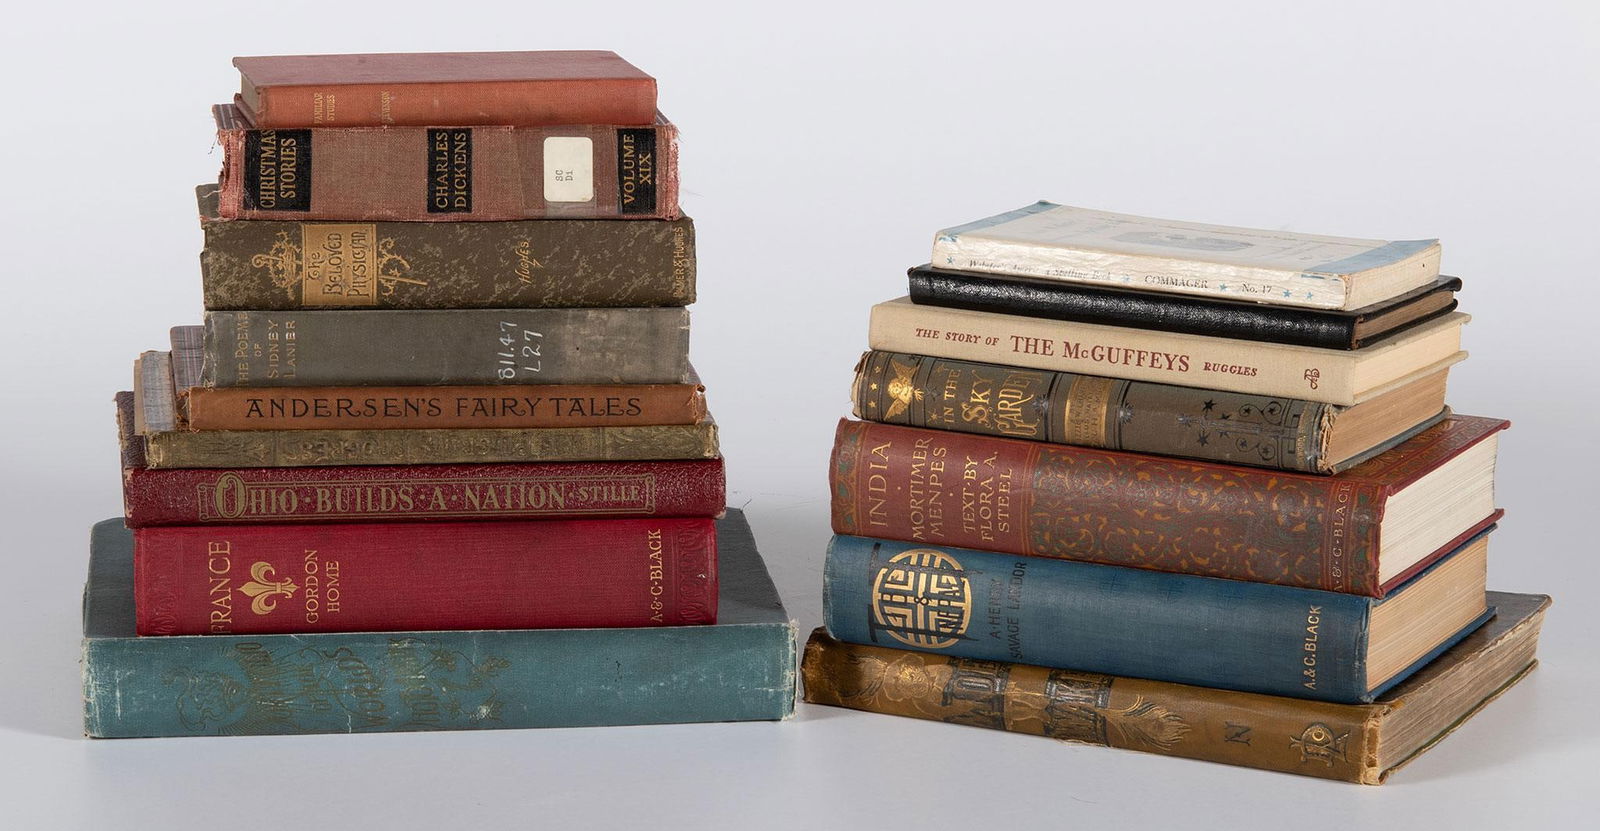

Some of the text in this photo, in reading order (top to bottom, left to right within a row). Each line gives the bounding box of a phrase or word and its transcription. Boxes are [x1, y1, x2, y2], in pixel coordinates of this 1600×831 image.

[260, 129, 277, 208] CHRISTMAS
[280, 138, 297, 198] STORIES
[435, 131, 449, 209] CHARLES
[454, 131, 467, 208] DICKENS
[555, 169, 564, 181] SC
[623, 133, 635, 205] VOLUME
[640, 152, 652, 185] XIX
[1144, 274, 1208, 290] COMMAGER
[1241, 283, 1273, 294] No. 17
[235, 311, 249, 387] THE POEMS
[253, 343, 262, 357] OF
[268, 319, 279, 378] SIDNEY
[283, 320, 296, 378] LANIER
[498, 321, 518, 380] 811.47
[522, 329, 543, 373] L27
[915, 327, 1258, 377] THE STORY OF THE McGUFFEYS RUGGLES
[245, 397, 643, 418] ANDERSEN'S FAIRY TALES
[943, 368, 961, 423] IN THE
[962, 369, 994, 428] SKY
[315, 485, 415, 514] BUILDS
[463, 482, 566, 512] NATION
[577, 485, 640, 502] STILLE
[868, 440, 892, 528] INDIA
[910, 437, 934, 540] MORTIMER
[929, 447, 947, 537] MENPES
[979, 450, 998, 542] FLORA A.
[997, 468, 1013, 533] STEEL
[208, 540, 232, 634] FRANCE
[305, 549, 319, 624] GORDON
[326, 560, 340, 613] HOME
[1009, 561, 1028, 610] LANDOR
[1007, 615, 1023, 660] SAVAGE
